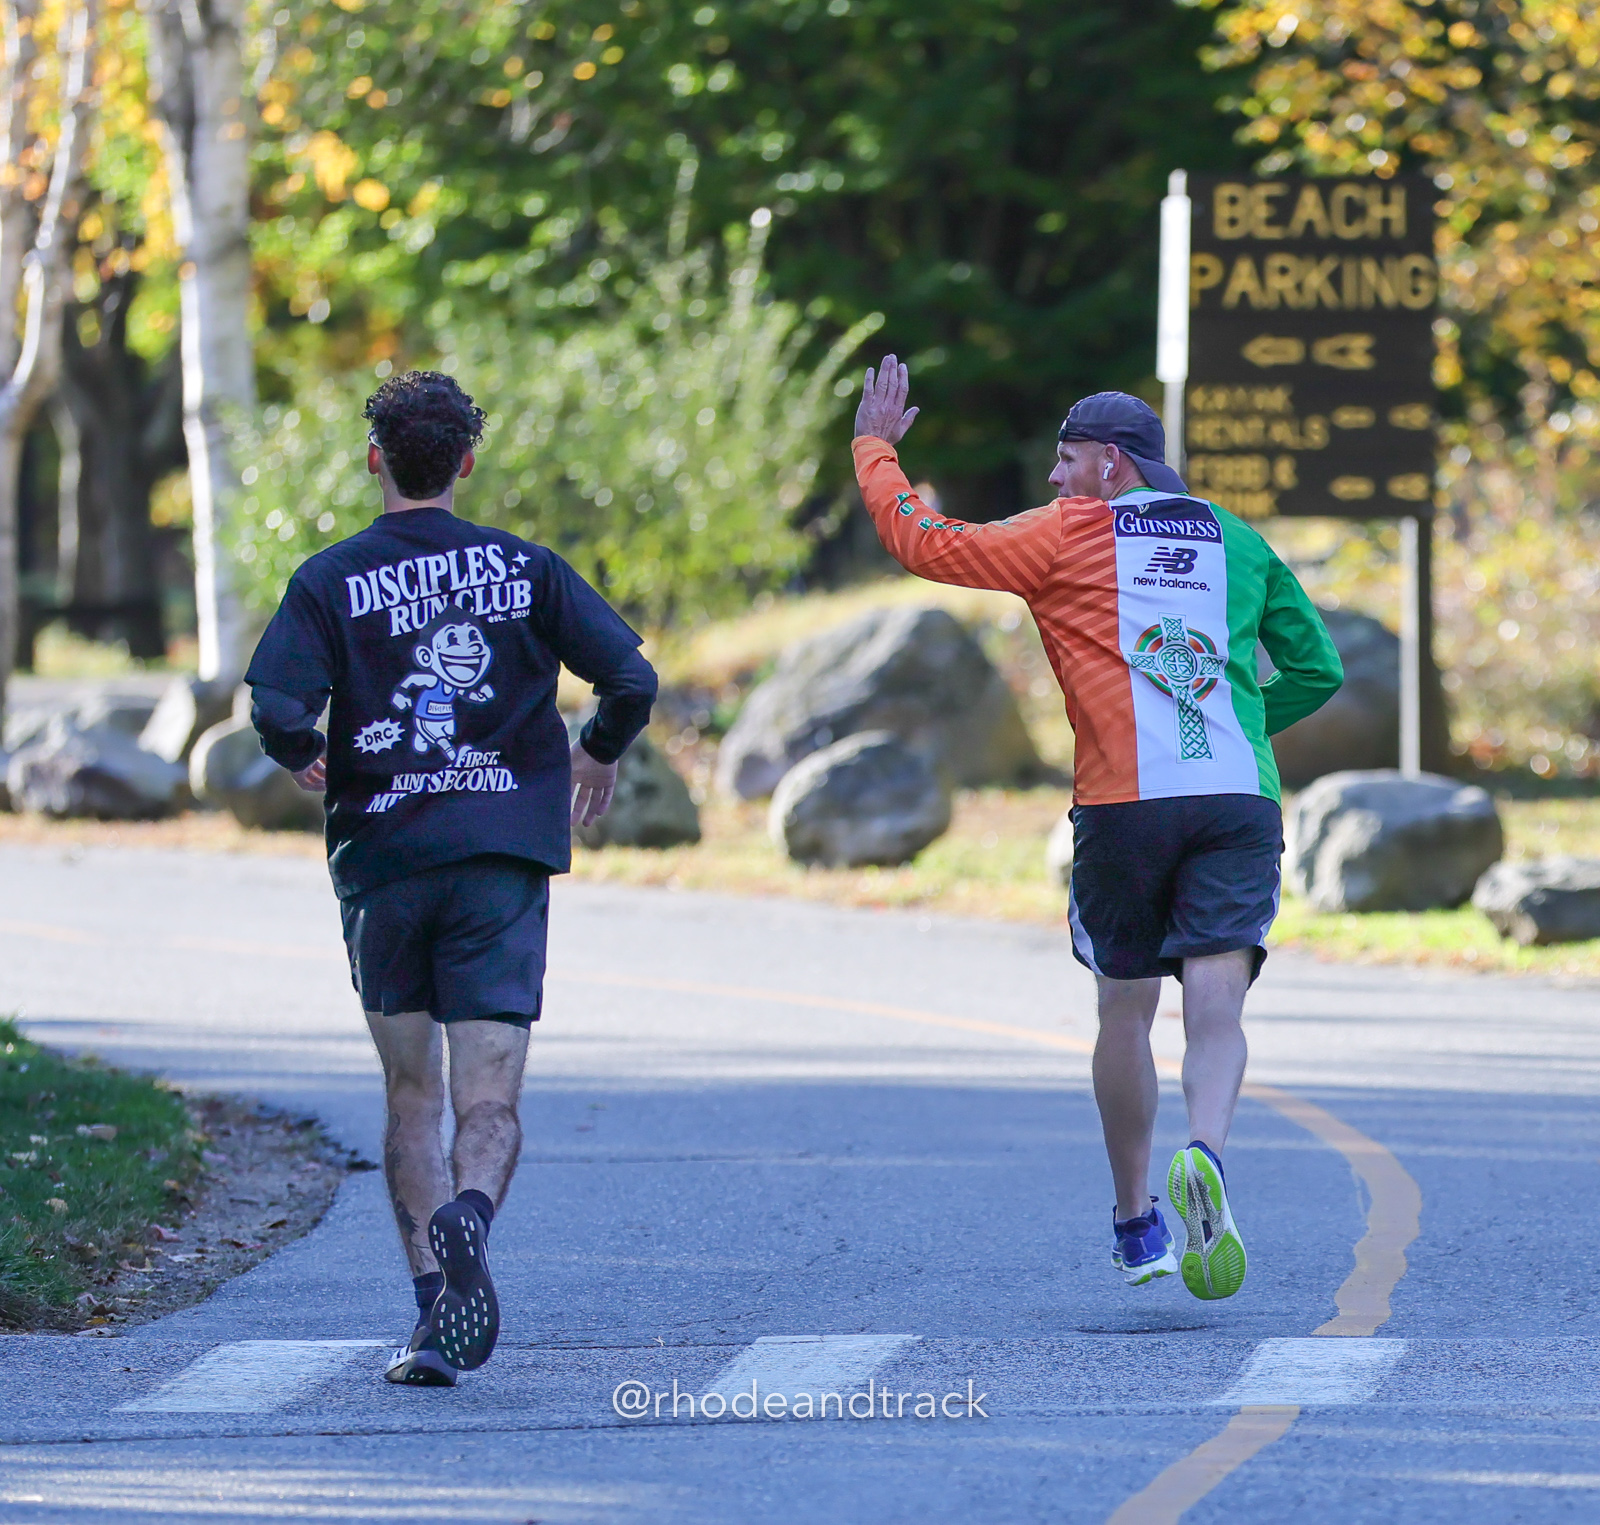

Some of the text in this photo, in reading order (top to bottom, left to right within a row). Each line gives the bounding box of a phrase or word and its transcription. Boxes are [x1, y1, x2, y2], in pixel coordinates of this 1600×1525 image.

[1213, 182, 1407, 239] BEACH
[1189, 253, 1438, 310] PARKING
[1119, 512, 1219, 537] GUINNESS
[346, 544, 507, 618] DISCIPLES
[1133, 576, 1157, 586] new
[389, 580, 532, 637] RUN CLUB
[487, 614, 507, 623] est.
[364, 727, 394, 747] DRC
